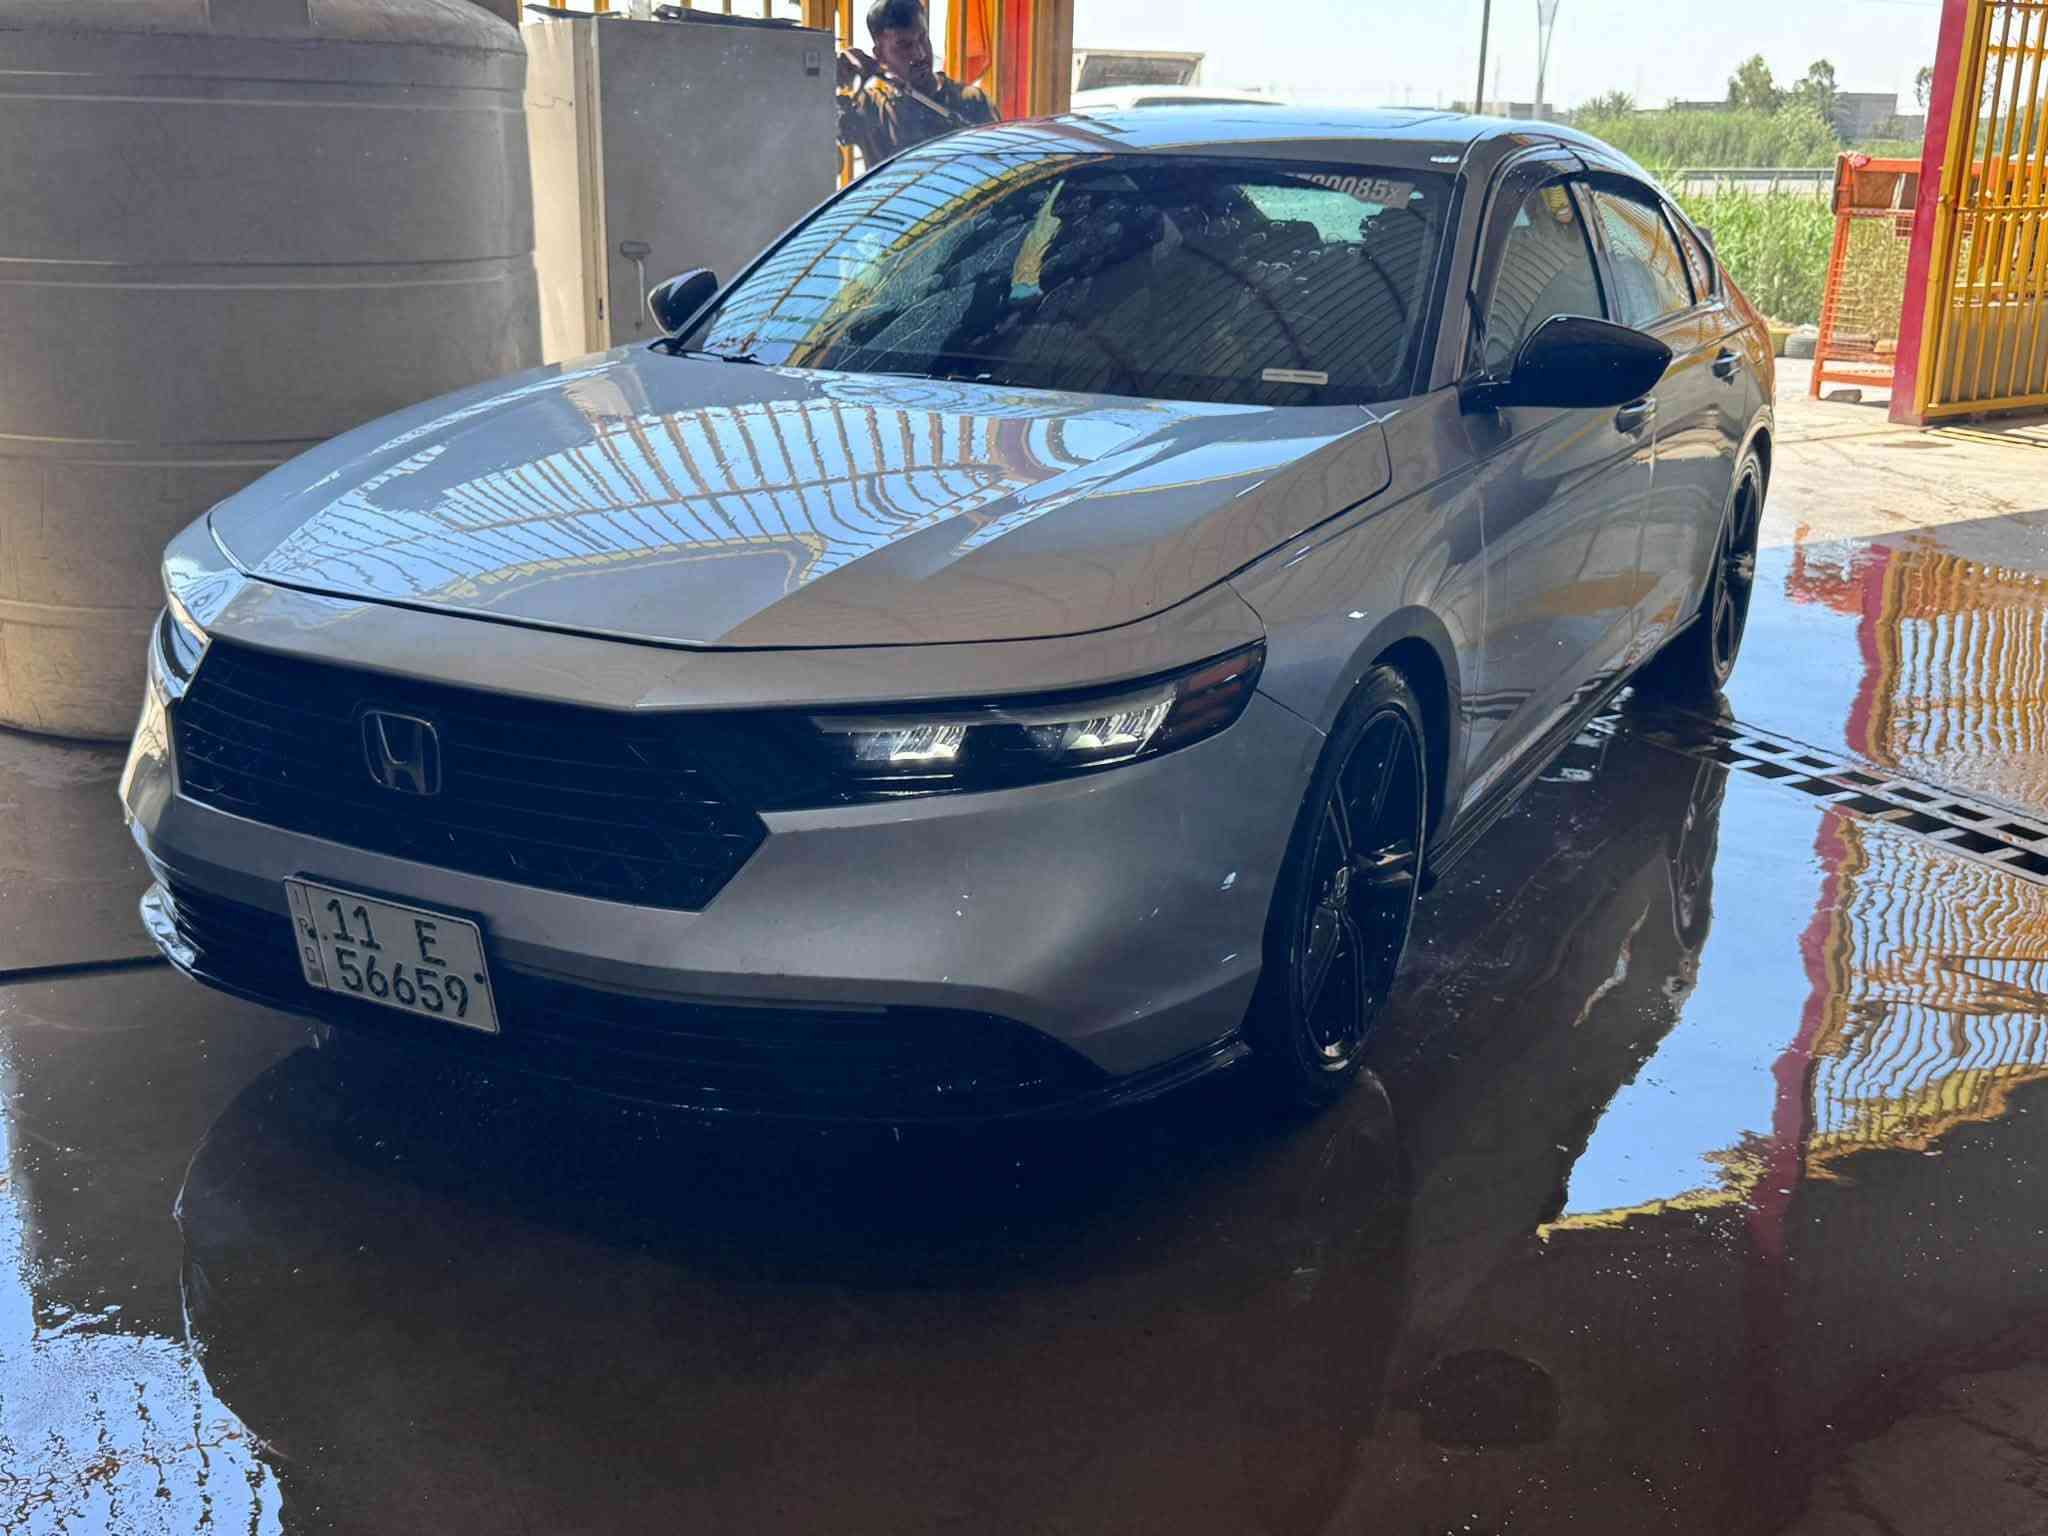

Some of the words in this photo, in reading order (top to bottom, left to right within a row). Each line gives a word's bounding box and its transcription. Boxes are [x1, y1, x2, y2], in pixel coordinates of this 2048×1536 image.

[327, 899, 382, 950] 11
[414, 919, 447, 967] E
[335, 947, 468, 1018] 56659
